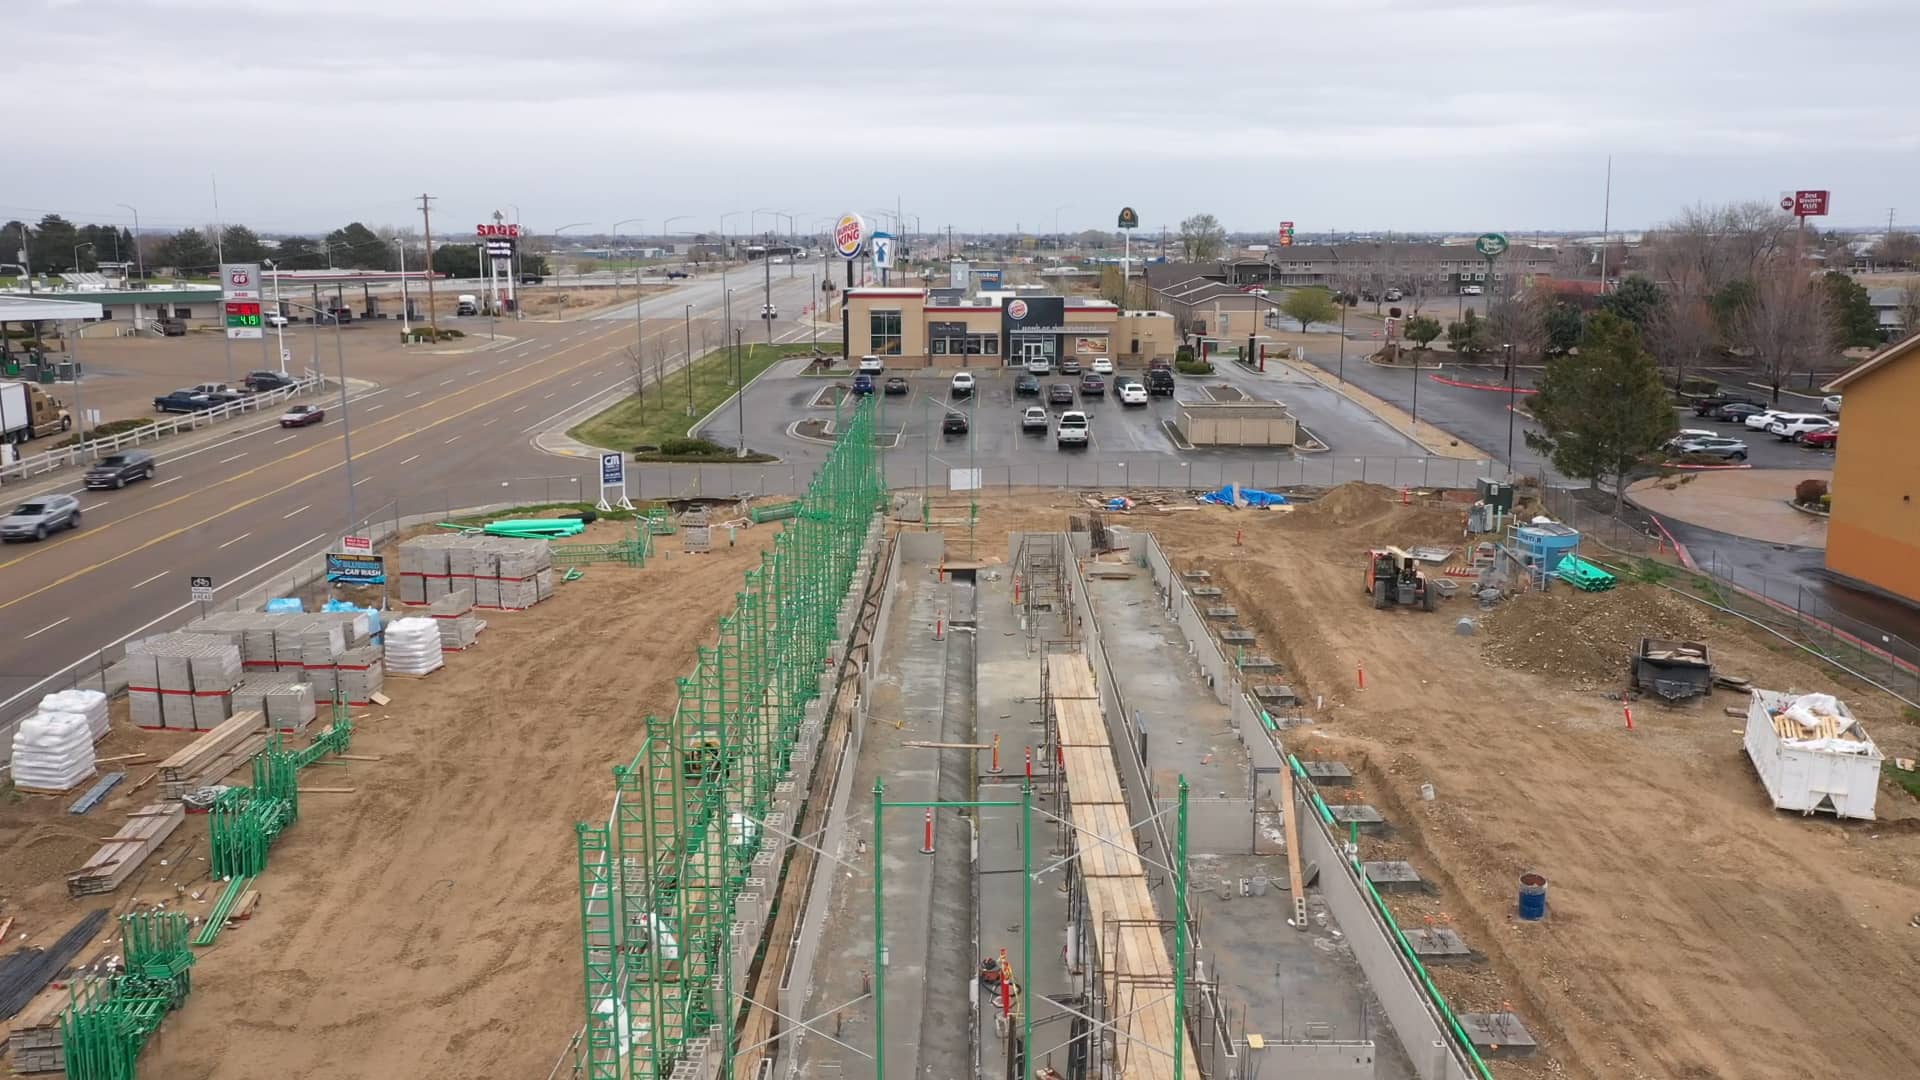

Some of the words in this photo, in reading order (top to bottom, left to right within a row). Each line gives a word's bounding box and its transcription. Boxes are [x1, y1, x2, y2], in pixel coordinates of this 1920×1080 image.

[476, 223, 518, 237] SAGE
[837, 221, 858, 236] BURGER
[838, 229, 860, 246] KING
[233, 275, 247, 283] 66
[360, 569, 382, 577] WASH
